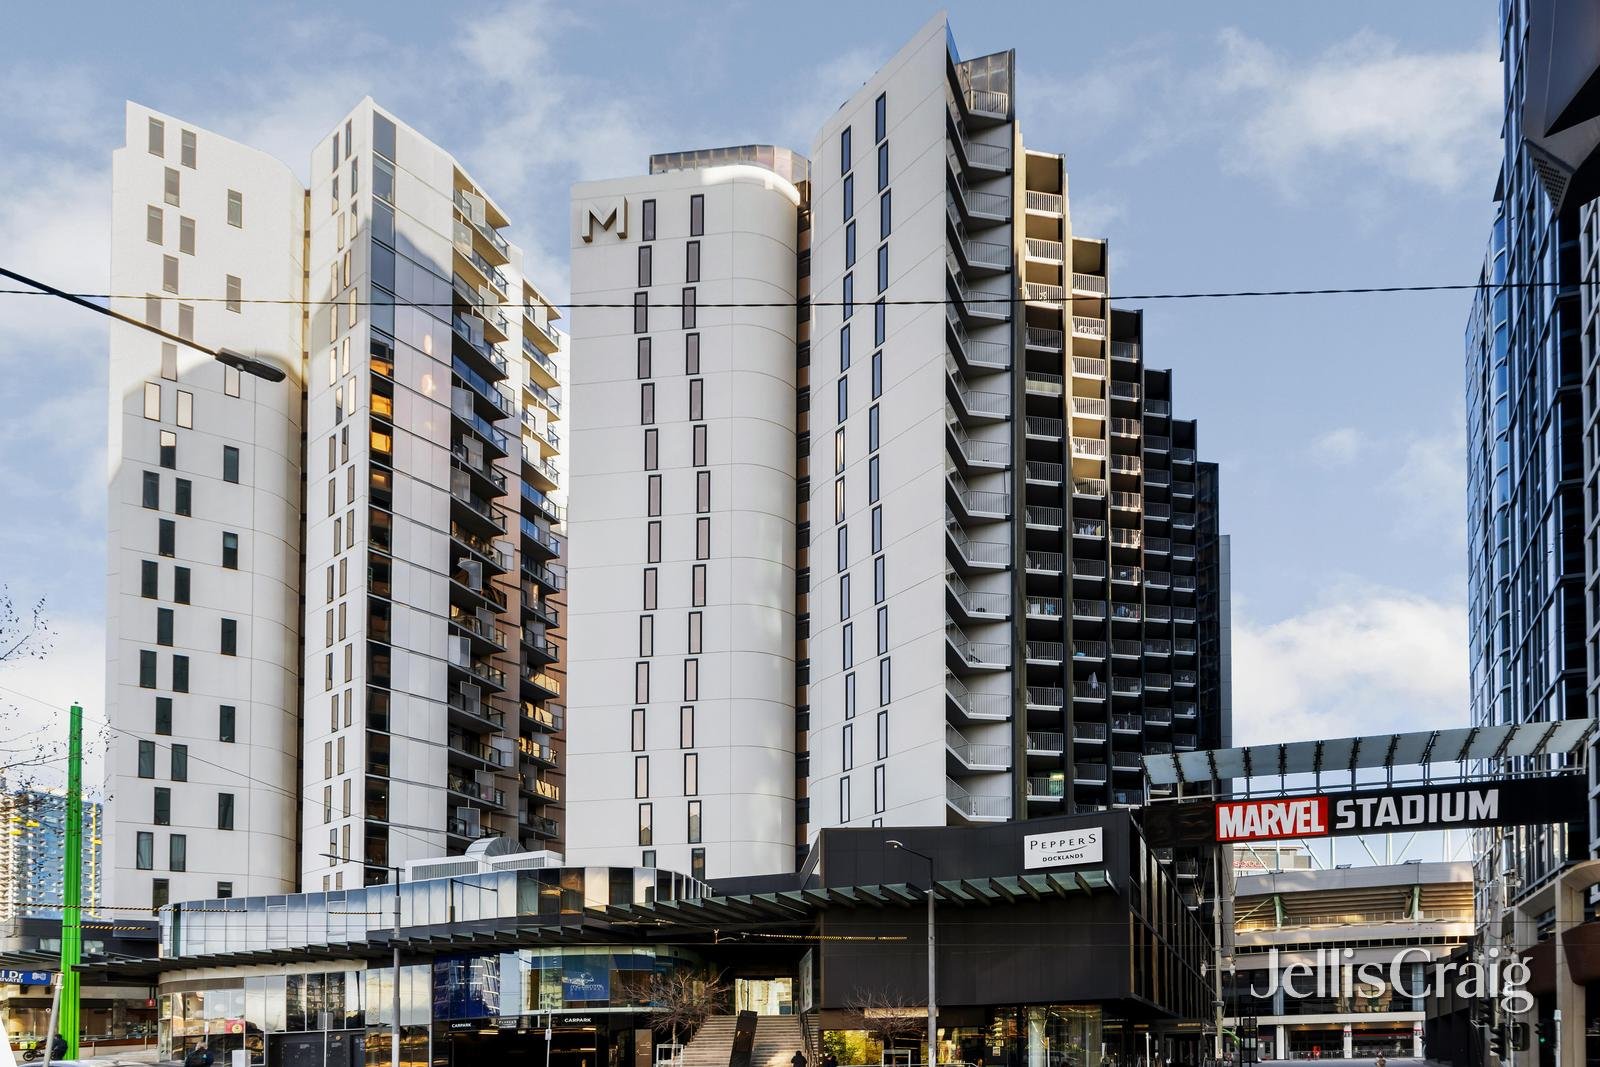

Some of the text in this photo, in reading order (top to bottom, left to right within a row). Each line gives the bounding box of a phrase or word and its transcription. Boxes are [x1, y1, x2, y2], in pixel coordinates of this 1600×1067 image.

[581, 194, 628, 243] M
[1219, 789, 1499, 838] MARVEL STADIUM
[1030, 833, 1097, 850] PEPPERS
[1042, 853, 1084, 862] DOCKLANDS
[9, 970, 24, 979] Dr
